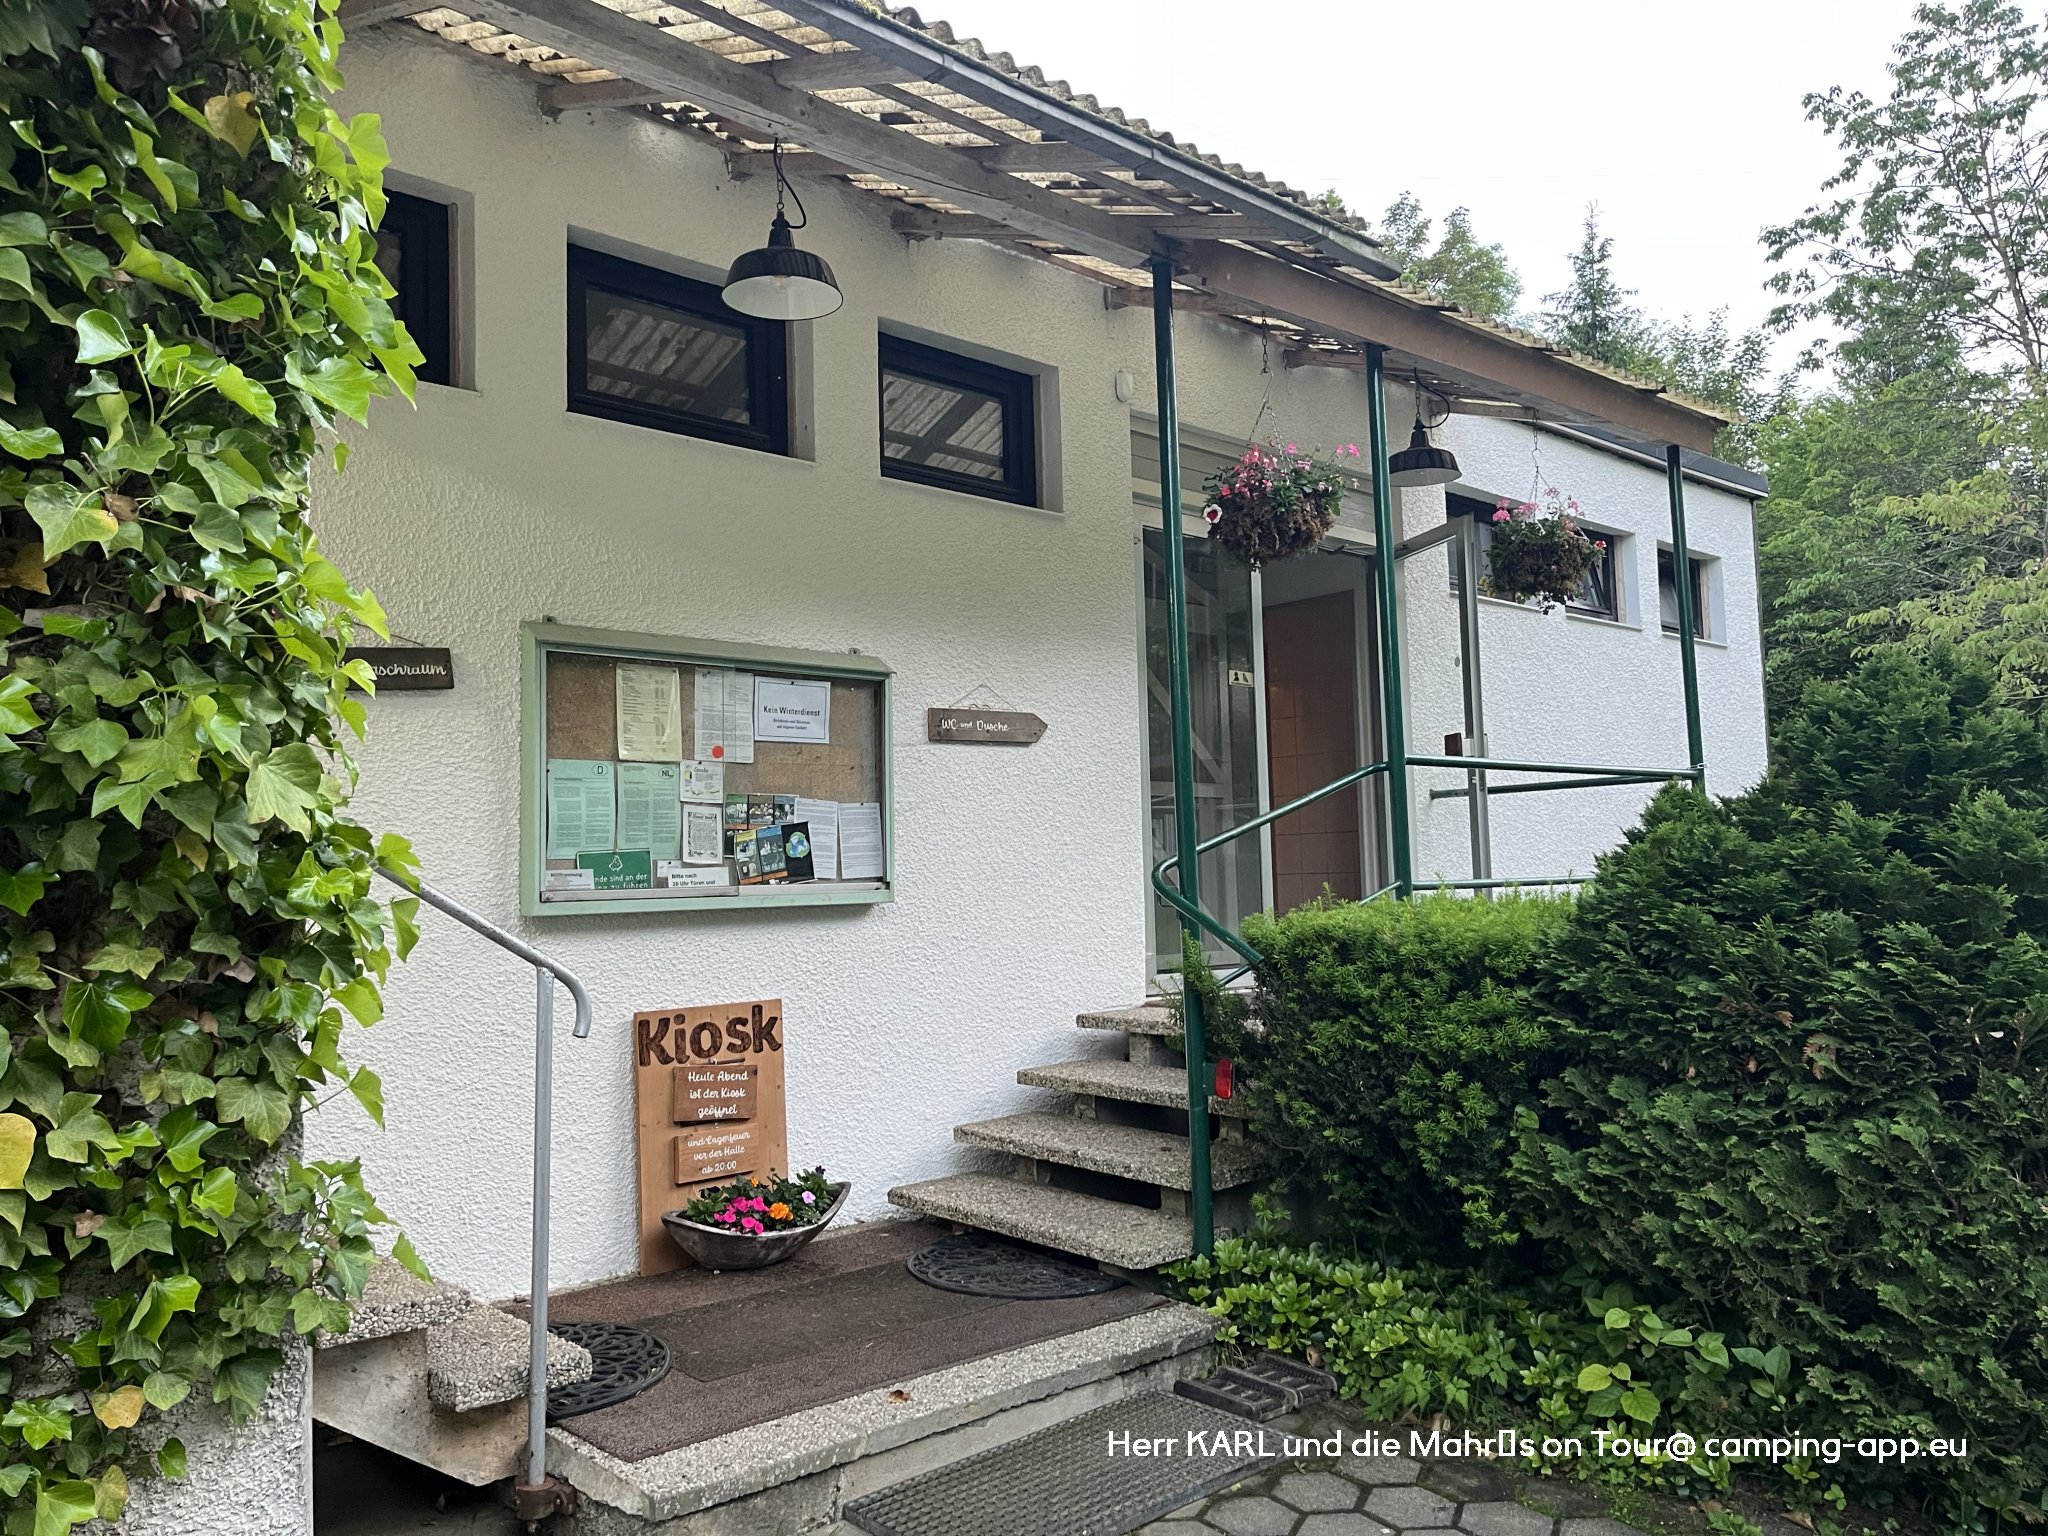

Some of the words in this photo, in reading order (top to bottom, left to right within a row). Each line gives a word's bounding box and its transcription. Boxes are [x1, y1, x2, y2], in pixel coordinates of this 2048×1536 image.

[763, 705, 778, 714] Kein
[779, 706, 820, 717] Winterdienst
[942, 718, 958, 730] WC
[976, 719, 1010, 732] Dusche
[661, 770, 673, 778] NL
[609, 874, 623, 882] sind
[637, 1004, 783, 1067] Kiosk
[688, 1071, 715, 1083] Heute
[717, 1070, 749, 1082] Abend
[689, 1089, 702, 1100] ist
[703, 1088, 720, 1099] der
[721, 1087, 746, 1099] Kiosk
[698, 1103, 738, 1119] geöffnet
[687, 1137, 706, 1148] und
[706, 1131, 751, 1147] Lagerfeuer
[693, 1152, 708, 1161] vor
[708, 1149, 724, 1160] der
[724, 1145, 745, 1157] Halle
[701, 1164, 714, 1175] ab
[714, 1160, 737, 1172] 20:00
